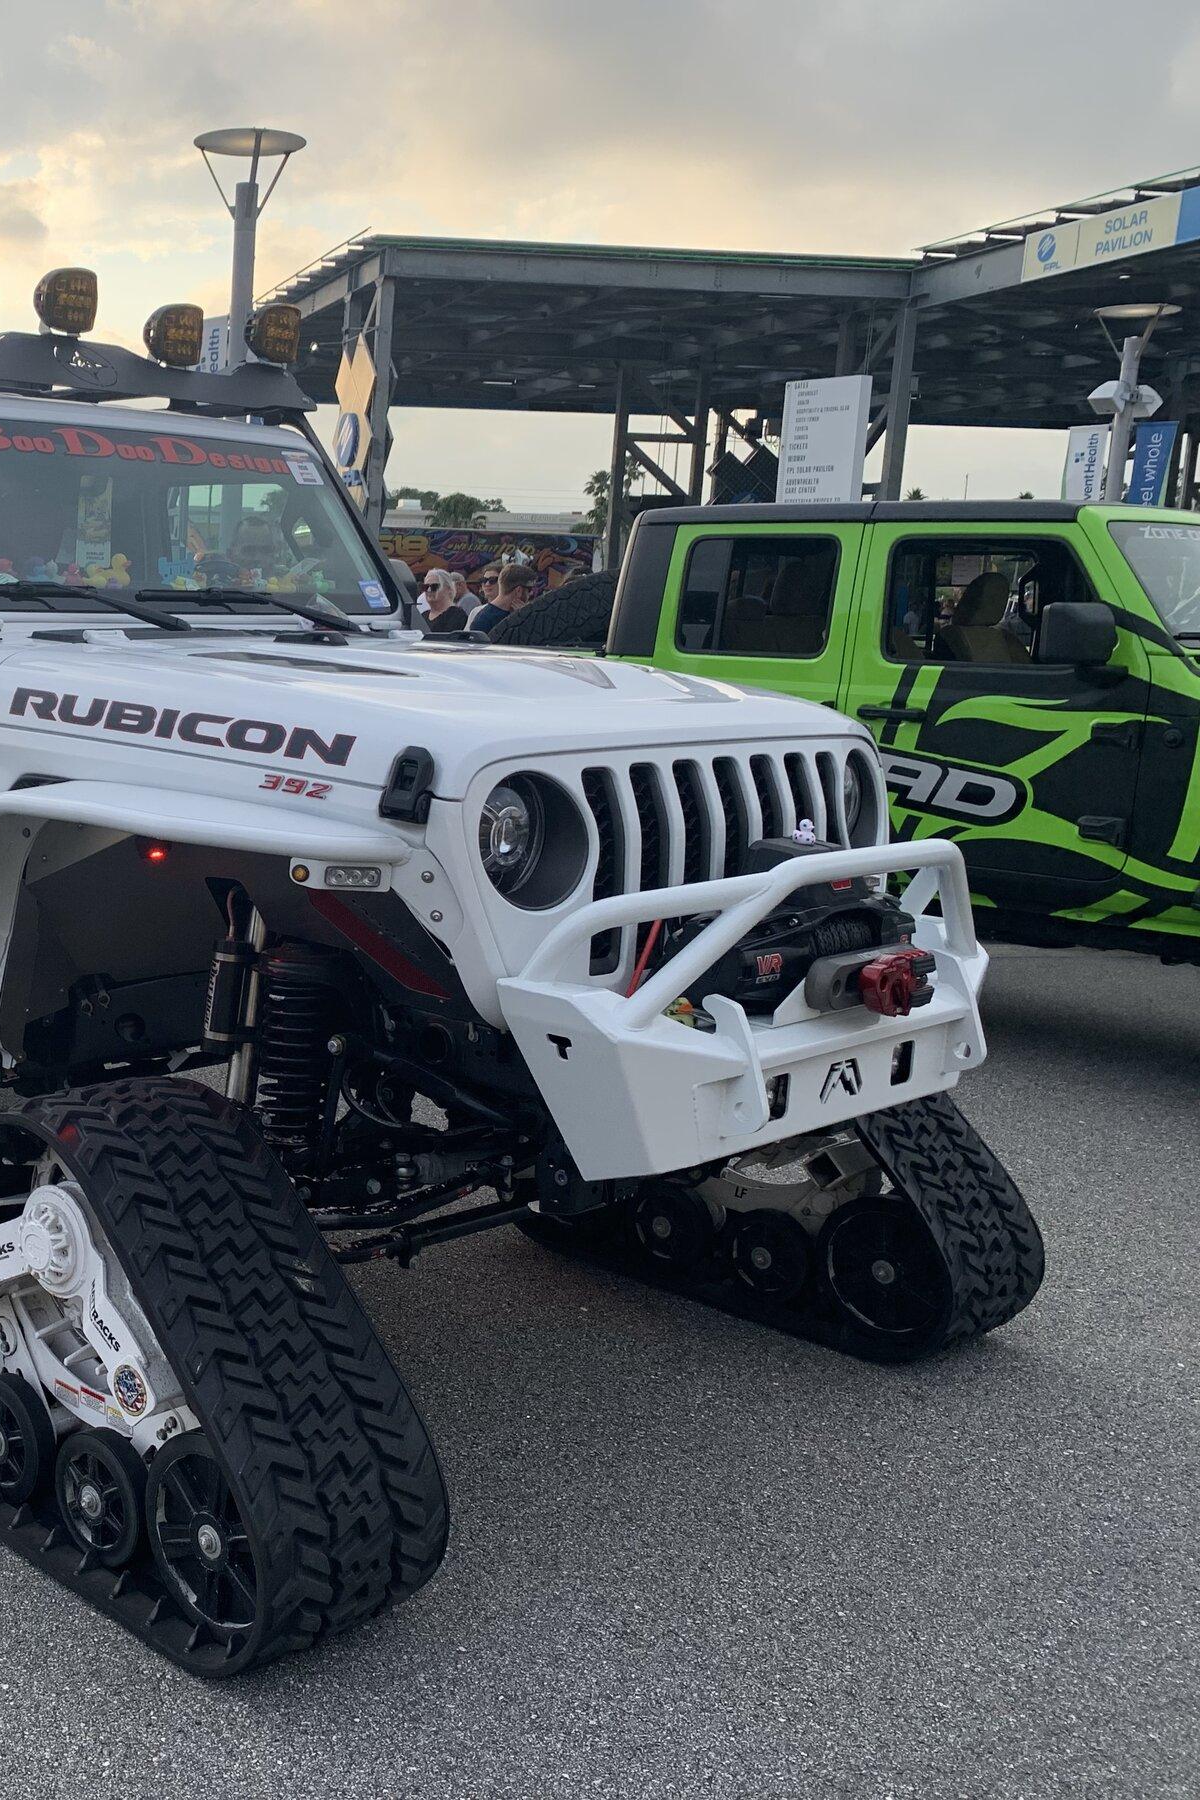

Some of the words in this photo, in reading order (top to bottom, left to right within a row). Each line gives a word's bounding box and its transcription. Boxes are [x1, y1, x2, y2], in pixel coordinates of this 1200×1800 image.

[1095, 229, 1153, 256] PAVILION
[1104, 210, 1148, 234] SOLAR
[1043, 261, 1063, 273] FPL
[208, 327, 220, 374] ealth
[52, 427, 156, 461] Doo
[151, 437, 291, 475] Design
[1084, 433, 1099, 500] ventHealth
[1144, 432, 1163, 481] whole
[9, 687, 357, 767] RUBICON
[259, 774, 333, 800] 392
[880, 752, 1017, 817] AD
[734, 1185, 748, 1199] LF
